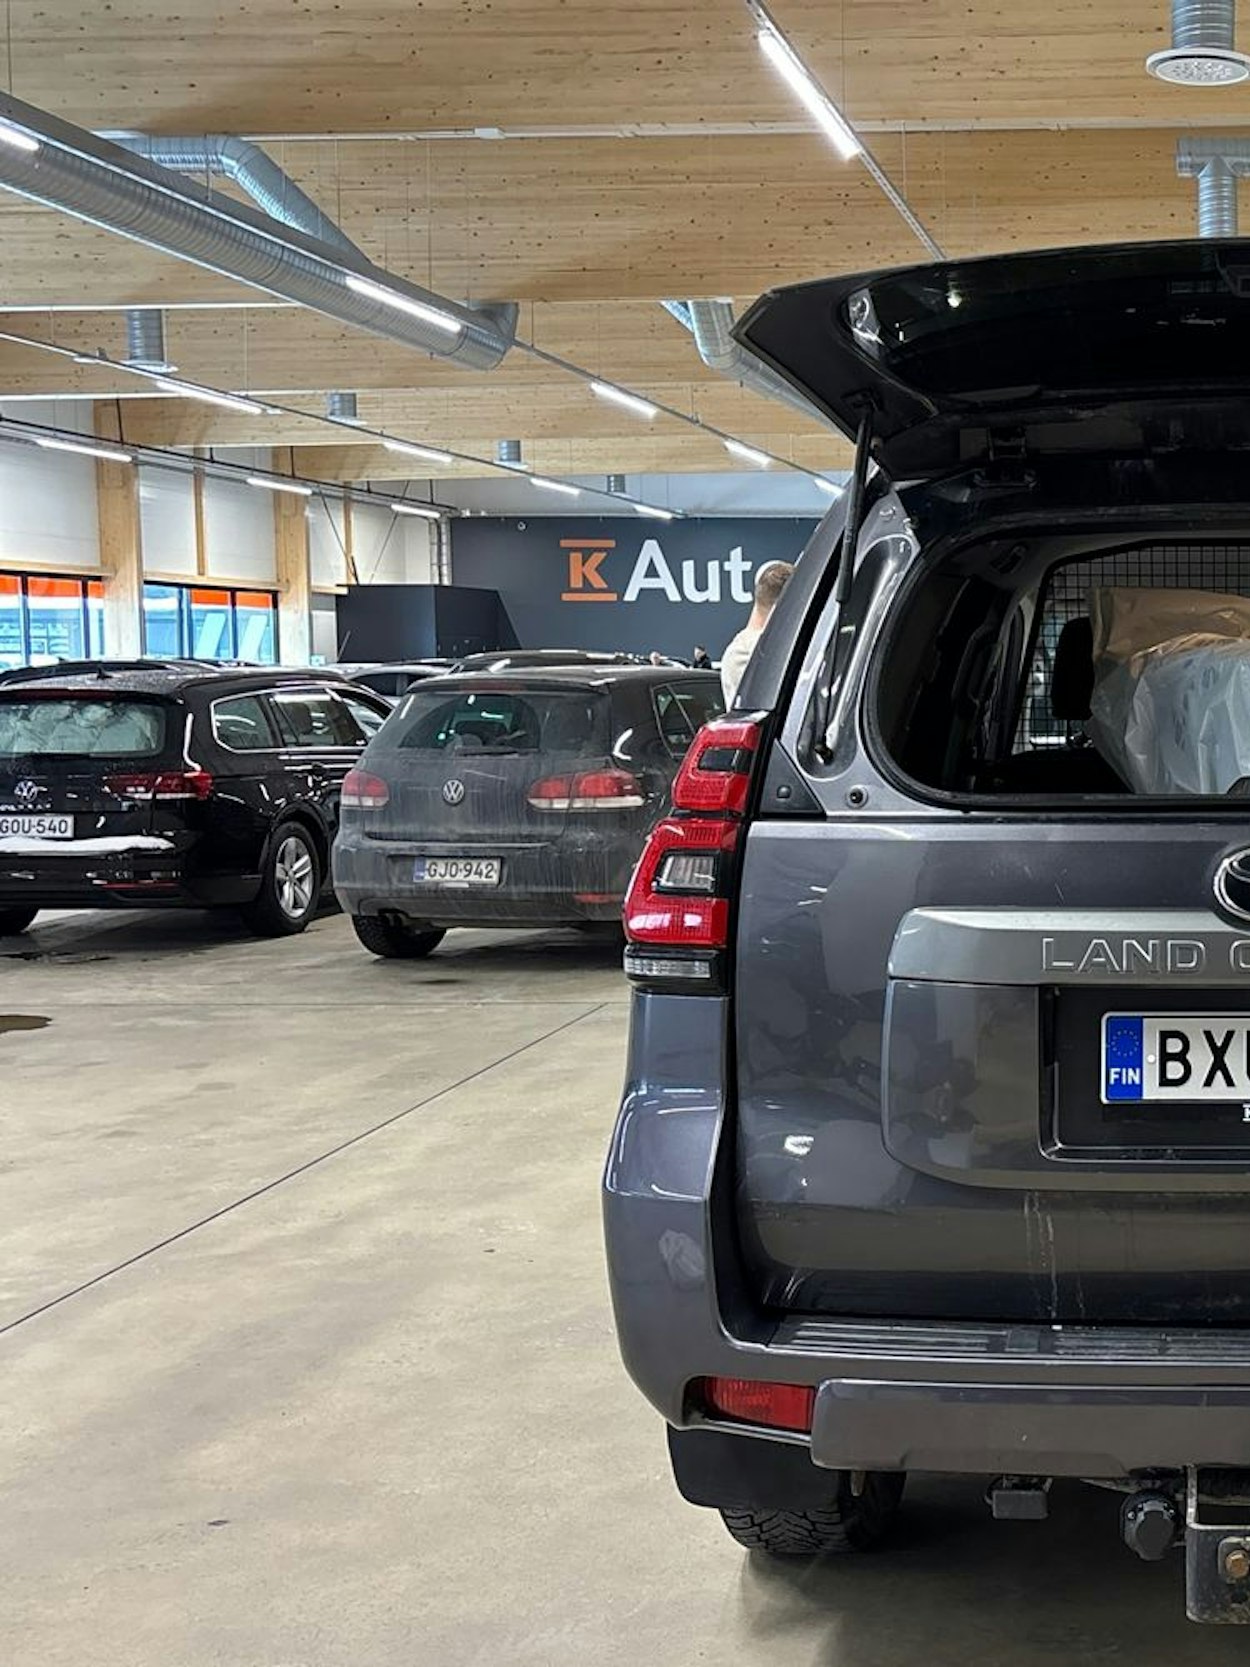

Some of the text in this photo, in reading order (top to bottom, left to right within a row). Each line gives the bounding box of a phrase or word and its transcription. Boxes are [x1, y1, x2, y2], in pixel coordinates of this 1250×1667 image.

[0, 819, 68, 835] GOU-540
[428, 861, 495, 880] GJO-942
[1041, 937, 1207, 974] LAND
[1109, 1067, 1141, 1085] FIN
